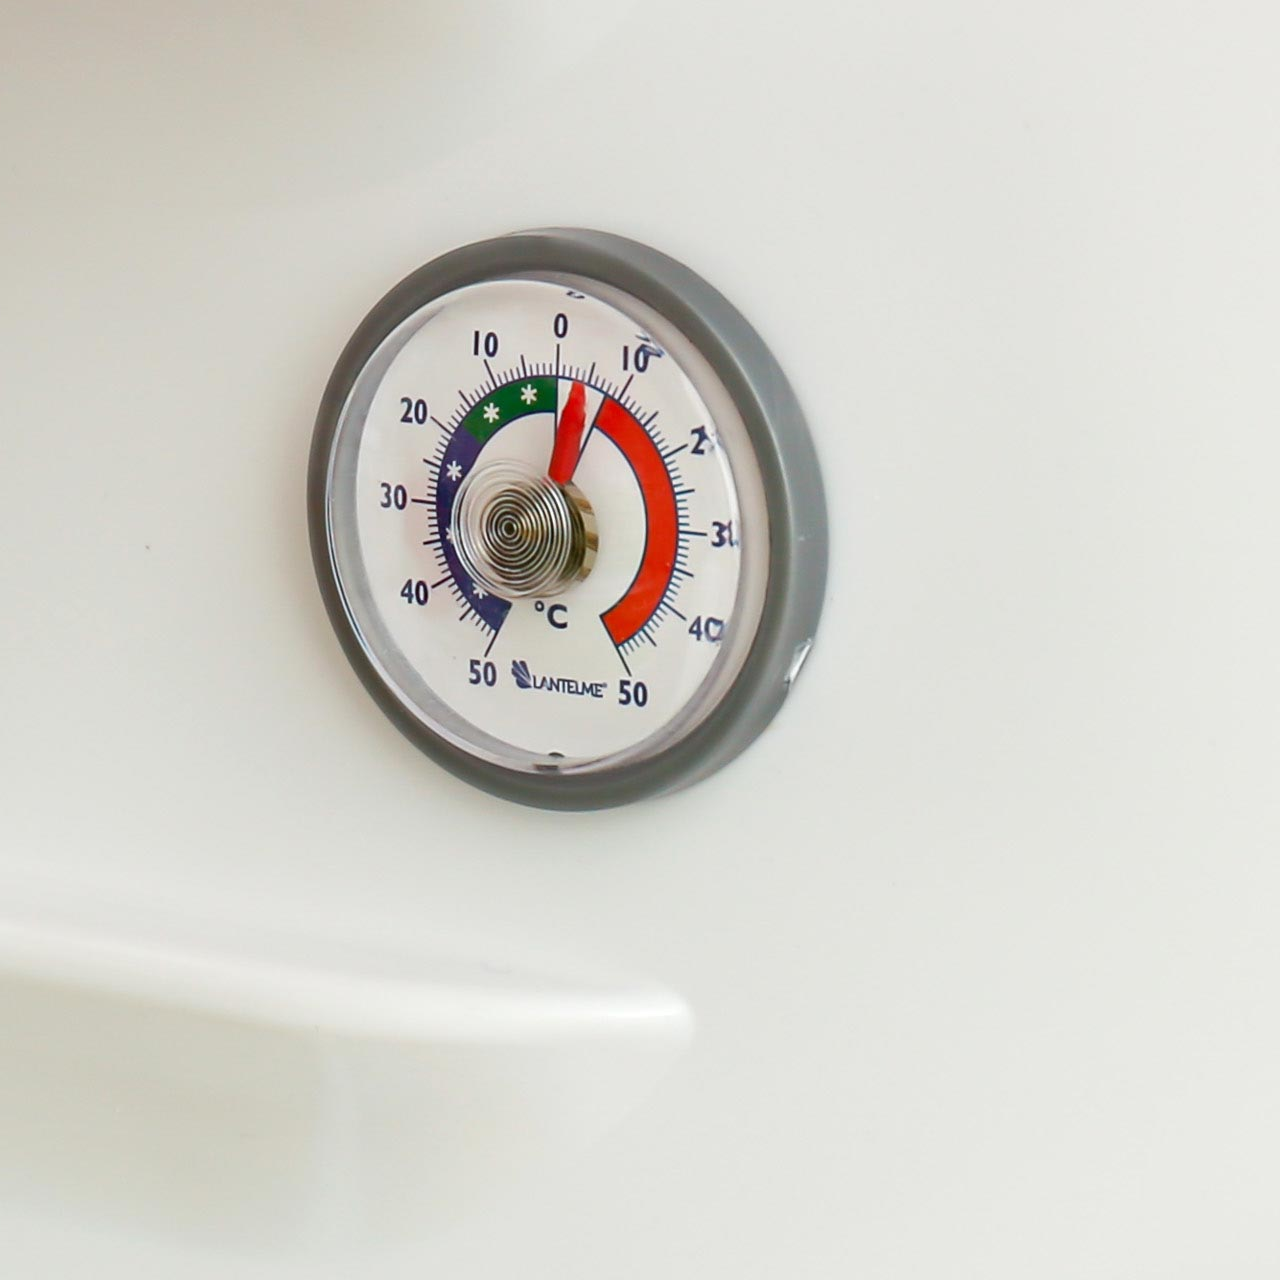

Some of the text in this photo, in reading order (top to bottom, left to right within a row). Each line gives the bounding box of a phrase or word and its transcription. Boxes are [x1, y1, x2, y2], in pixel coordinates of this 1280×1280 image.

[554, 313, 568, 338] 0
[473, 330, 499, 358] 10
[622, 344, 650, 373] 10
[400, 397, 428, 425] 20
[380, 482, 408, 511] 30
[400, 579, 429, 606] 40
[469, 659, 497, 687] 50
[618, 679, 648, 707] 50
